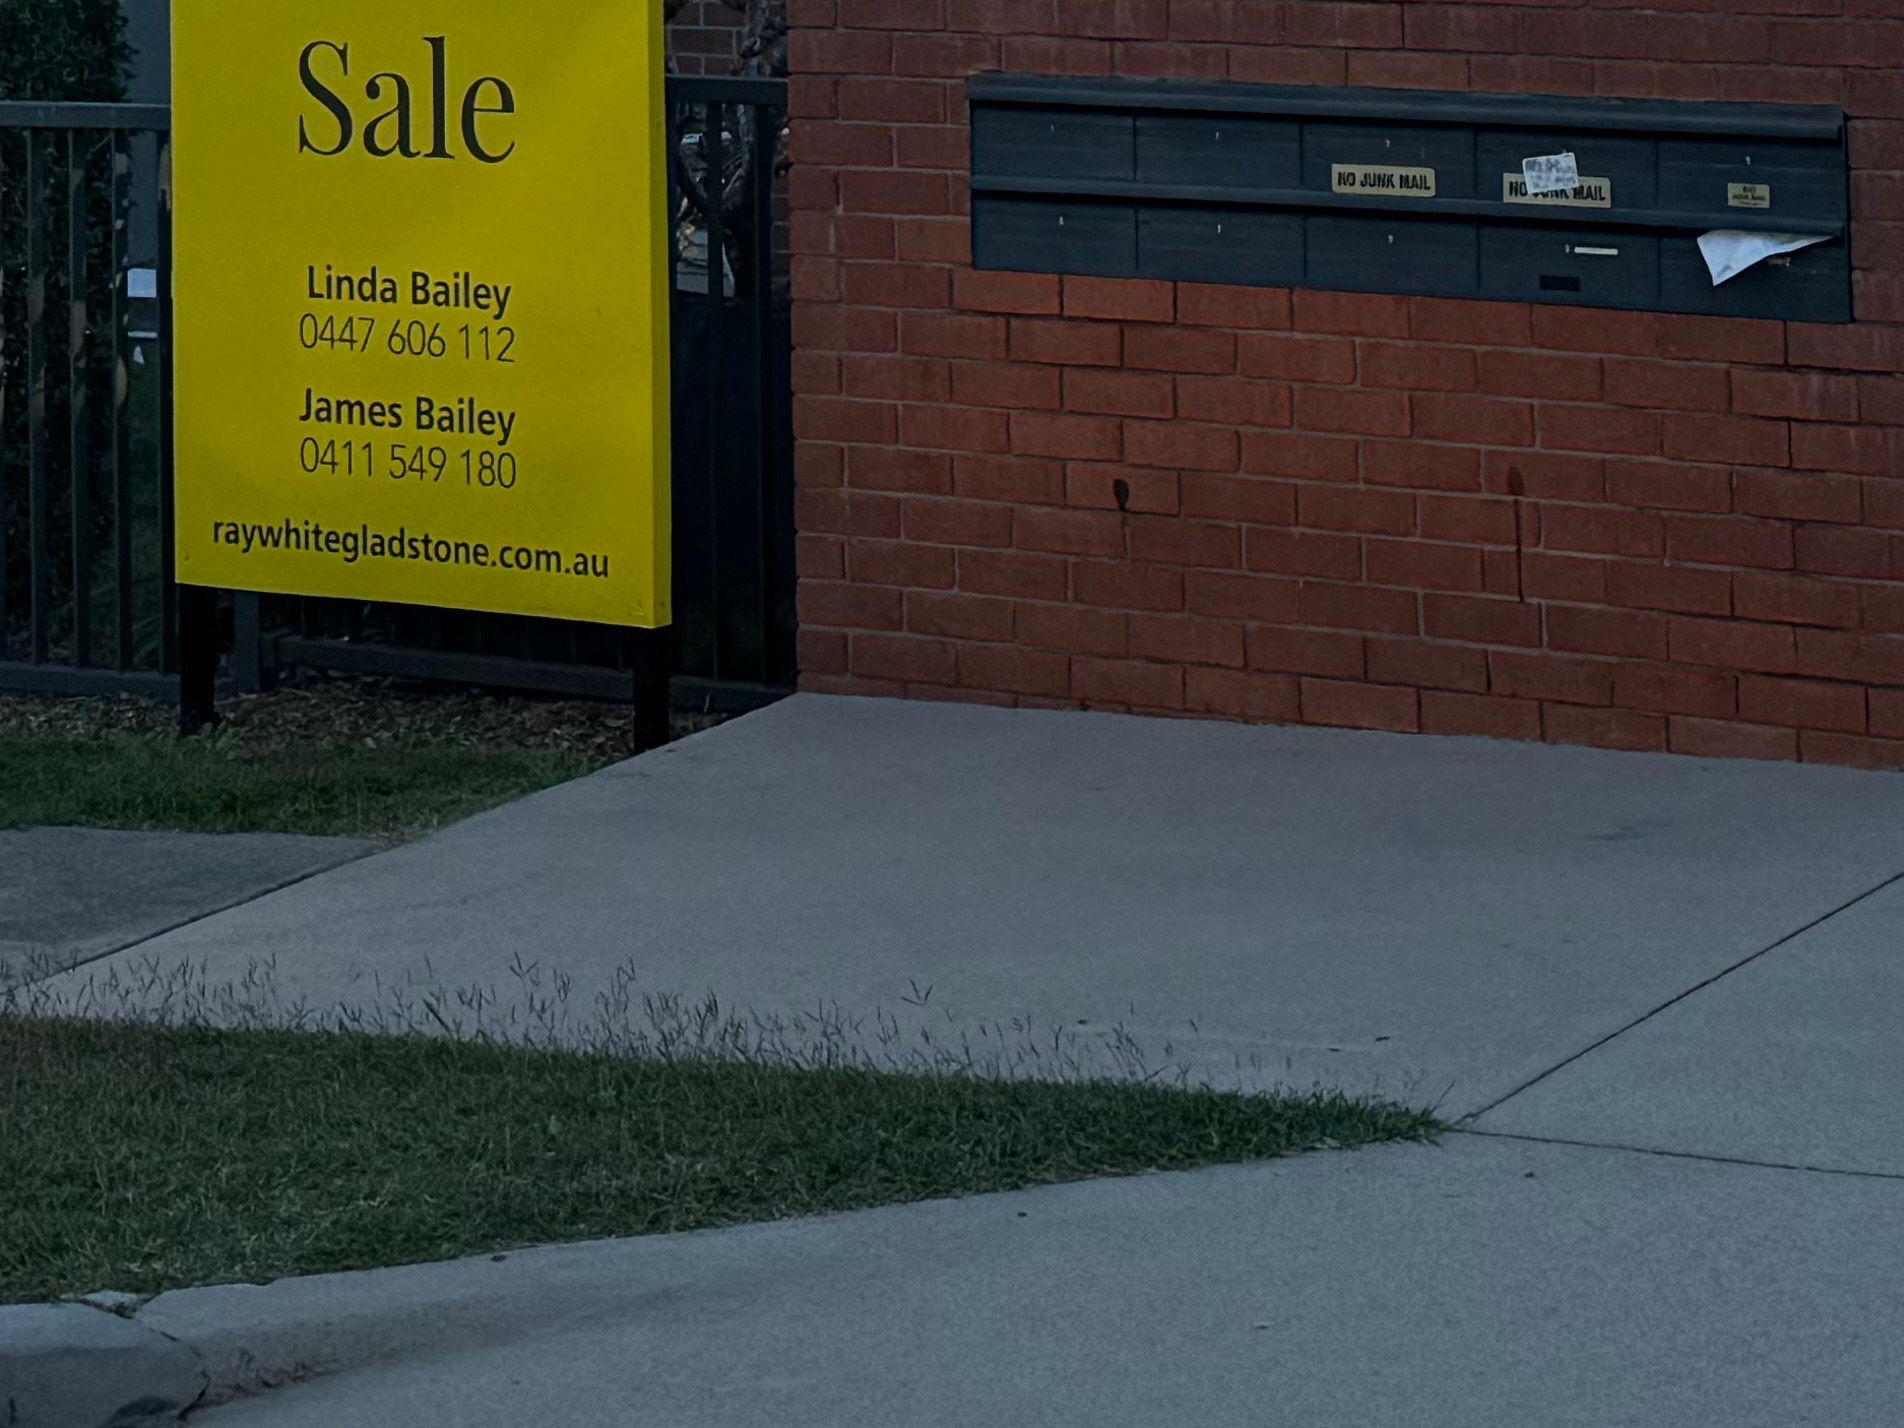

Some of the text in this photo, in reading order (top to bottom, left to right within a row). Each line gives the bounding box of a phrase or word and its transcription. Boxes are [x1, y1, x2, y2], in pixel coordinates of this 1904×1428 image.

[299, 35, 515, 164] Sale
[1337, 172, 1431, 190] NO JUNK MAIL
[308, 264, 511, 320] Linda Bailey
[299, 312, 515, 363] 0447 606 112
[299, 387, 516, 446] James Bailey
[300, 437, 516, 489] 0411 549 180
[213, 518, 609, 578] raywhitegladstone.com.au
